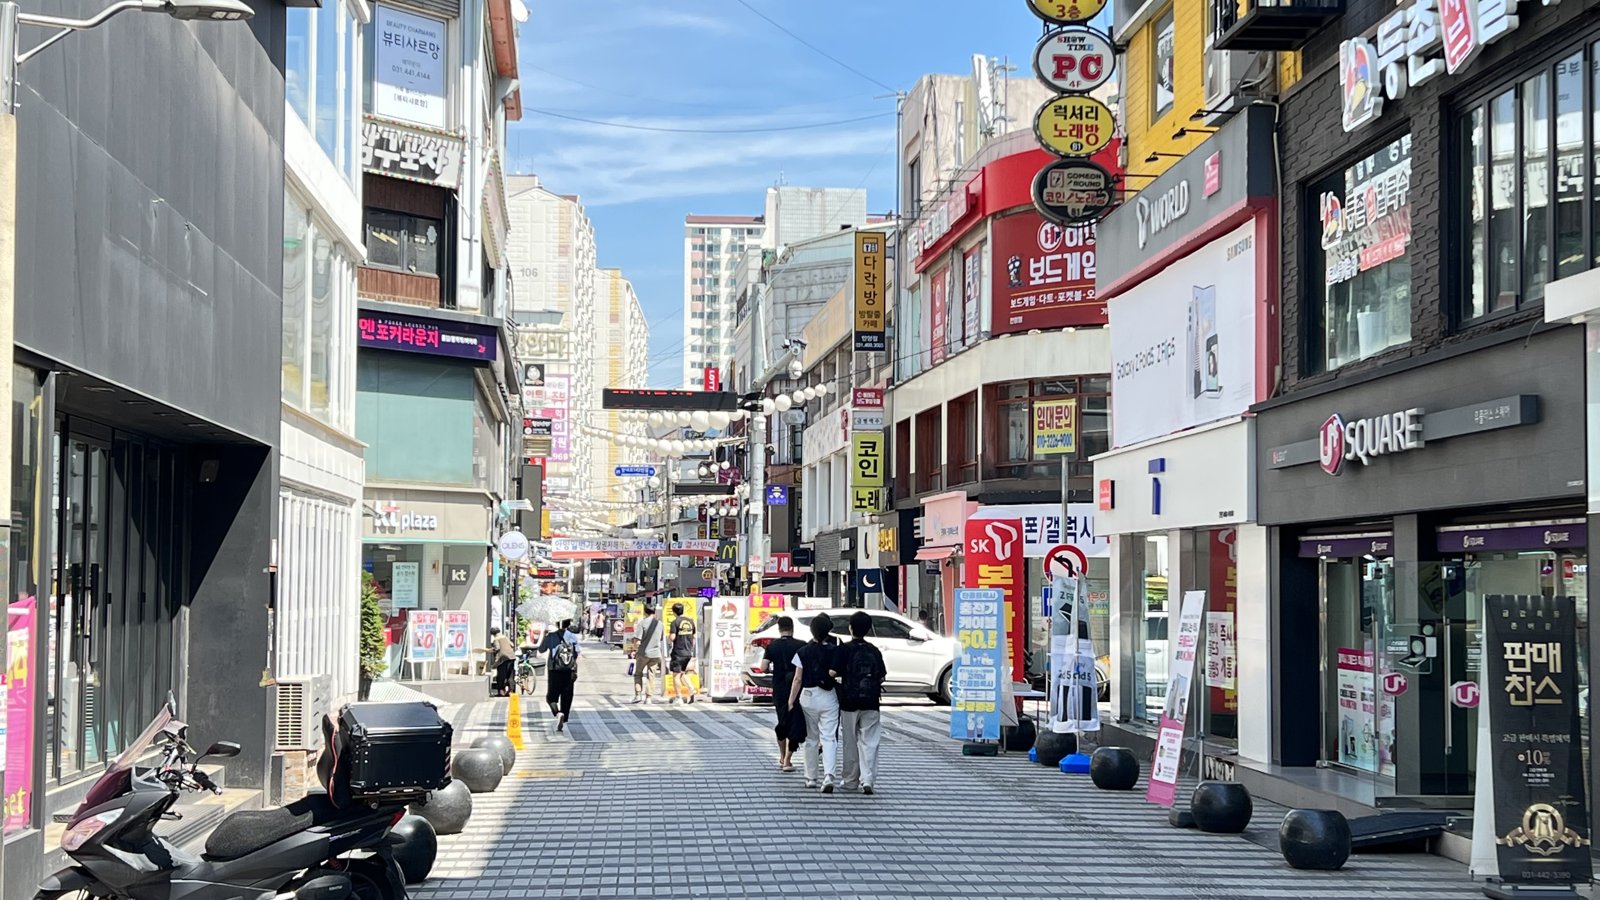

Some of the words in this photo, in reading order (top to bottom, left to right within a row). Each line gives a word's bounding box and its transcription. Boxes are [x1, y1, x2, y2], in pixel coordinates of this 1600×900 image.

[1056, 5, 1081, 18] 3층
[382, 30, 440, 60] 뷰티샤르망
[1052, 54, 1103, 81] PC
[1053, 104, 1099, 120] 럭셔리
[1053, 123, 1099, 146] 노래방
[1151, 179, 1190, 235] WORLD
[1227, 235, 1252, 261] SAMSUNG
[520, 267, 538, 277] 106
[863, 255, 878, 306] 다락방
[376, 323, 439, 348] 포커라운지
[1037, 405, 1073, 430] 임대문의
[1345, 408, 1421, 466] SQUARE
[858, 441, 879, 478] 코인
[855, 489, 880, 510] 노래
[401, 510, 437, 530] plaza
[970, 538, 990, 553] SK
[451, 568, 467, 581] kt
[959, 601, 998, 615] 충전기
[716, 622, 742, 638] 등촌
[958, 616, 998, 629] 케이블
[1503, 641, 1563, 673] 판매
[1504, 674, 1564, 706] 찬스
[1525, 749, 1544, 766] 10
